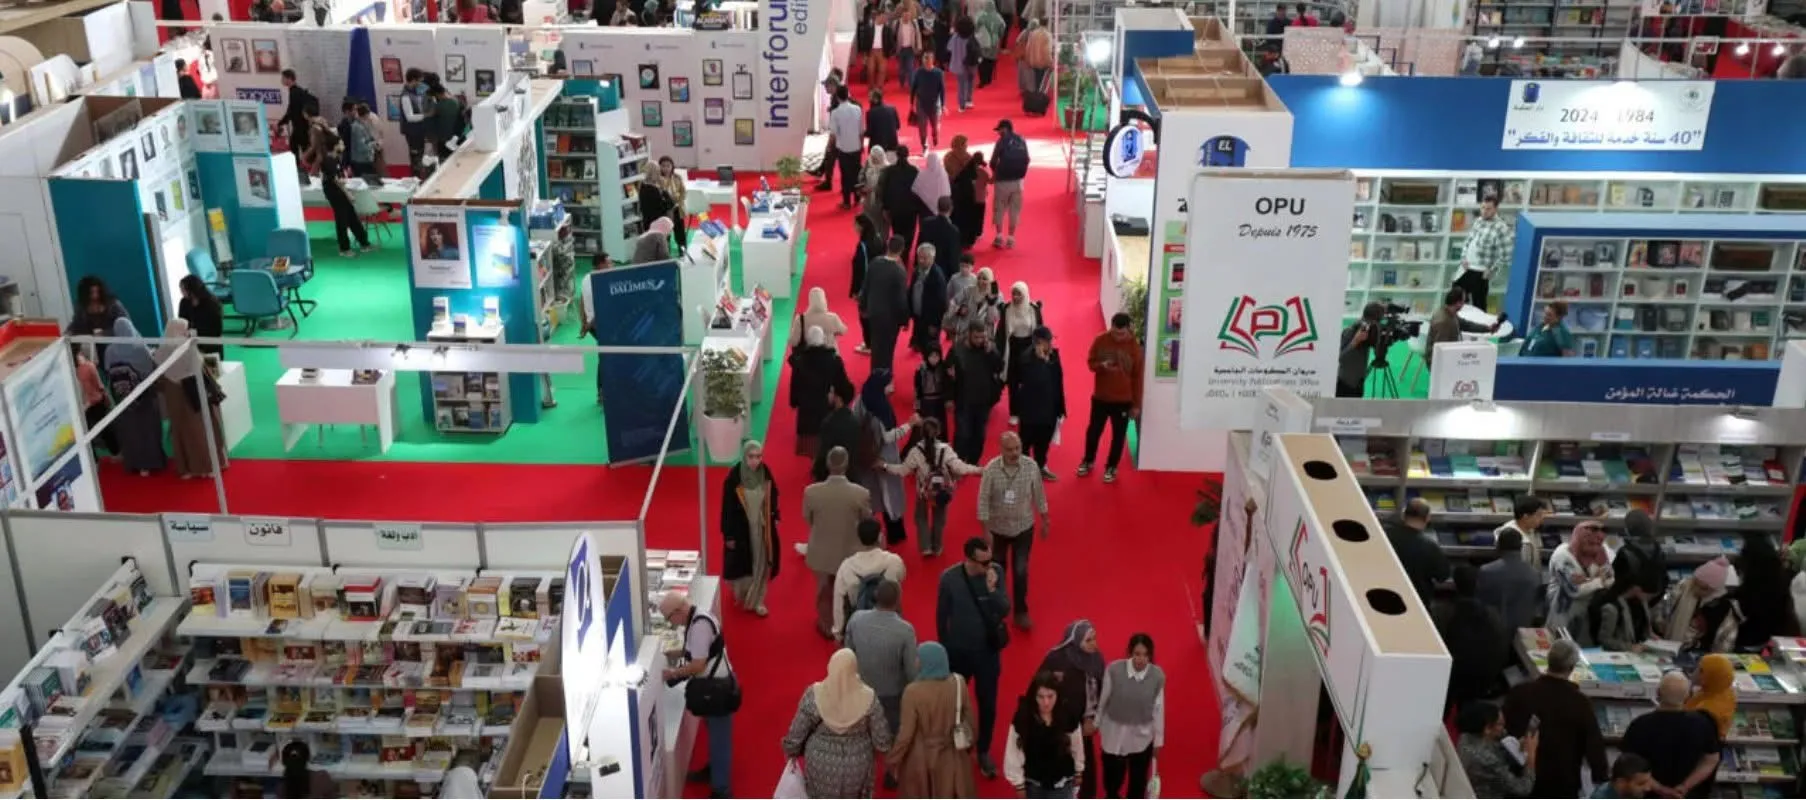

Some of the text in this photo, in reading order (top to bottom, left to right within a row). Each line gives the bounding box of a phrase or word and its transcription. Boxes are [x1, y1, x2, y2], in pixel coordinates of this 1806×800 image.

[1560, 108, 1599, 123] 2024
[1218, 139, 1232, 151] EL
[1642, 132, 1666, 145] سنة
[1255, 197, 1305, 215] OPU
[1238, 223, 1319, 239] Depuis 1975
[1604, 386, 1645, 400] المؤمن
[1681, 387, 1735, 400] الحكمة
[170, 521, 209, 534] سياسة
[249, 522, 283, 537] قانون
[1302, 561, 1318, 608] OPU
